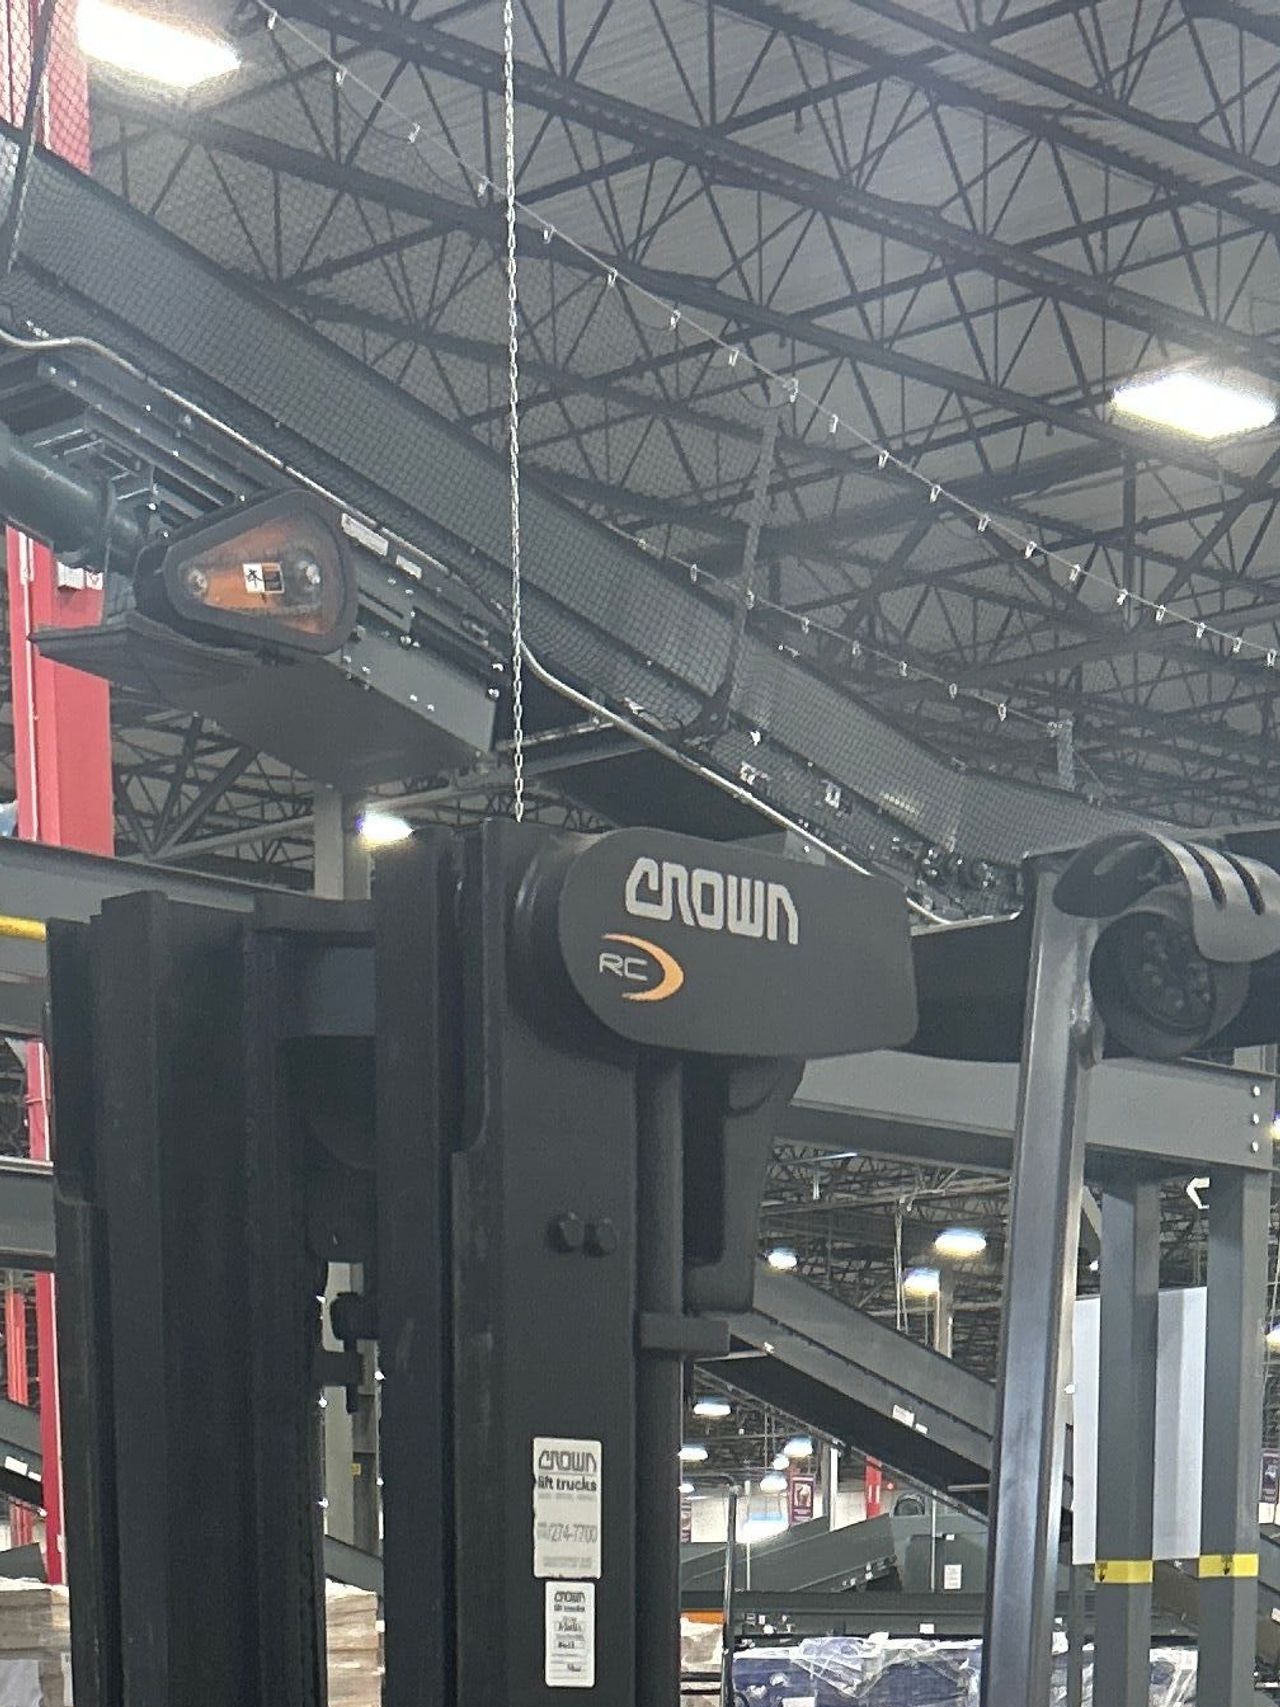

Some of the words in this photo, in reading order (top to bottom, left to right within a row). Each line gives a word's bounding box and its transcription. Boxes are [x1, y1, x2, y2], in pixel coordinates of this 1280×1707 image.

[625, 856, 799, 945] CROWN
[599, 952, 649, 981] RC
[538, 1450, 597, 1473] CROWN
[538, 1475, 554, 1490] lift
[556, 1476, 597, 1491] trucks
